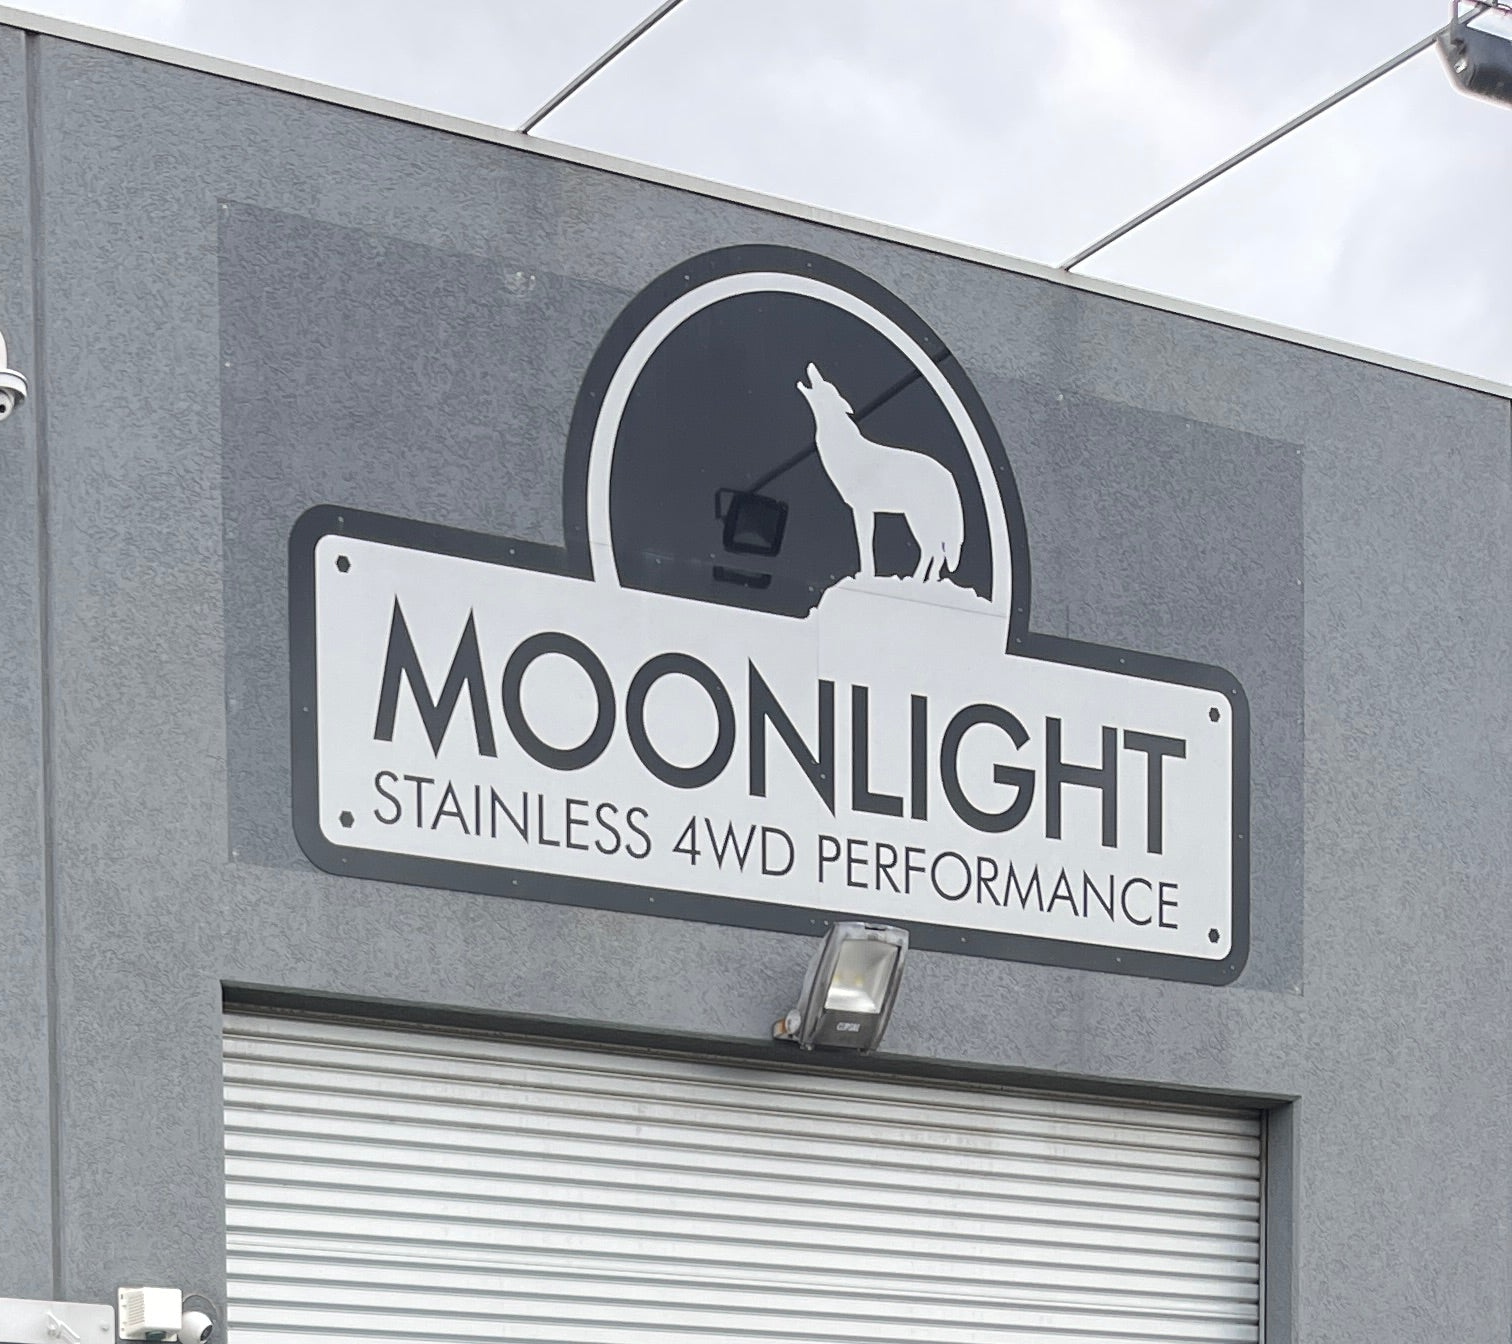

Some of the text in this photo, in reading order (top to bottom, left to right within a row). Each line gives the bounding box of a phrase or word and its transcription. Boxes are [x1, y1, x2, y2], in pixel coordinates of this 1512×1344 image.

[373, 592, 1188, 857] MOONLIGHT
[373, 768, 1180, 932] STAINLESS 4WD PERFORMANCE
